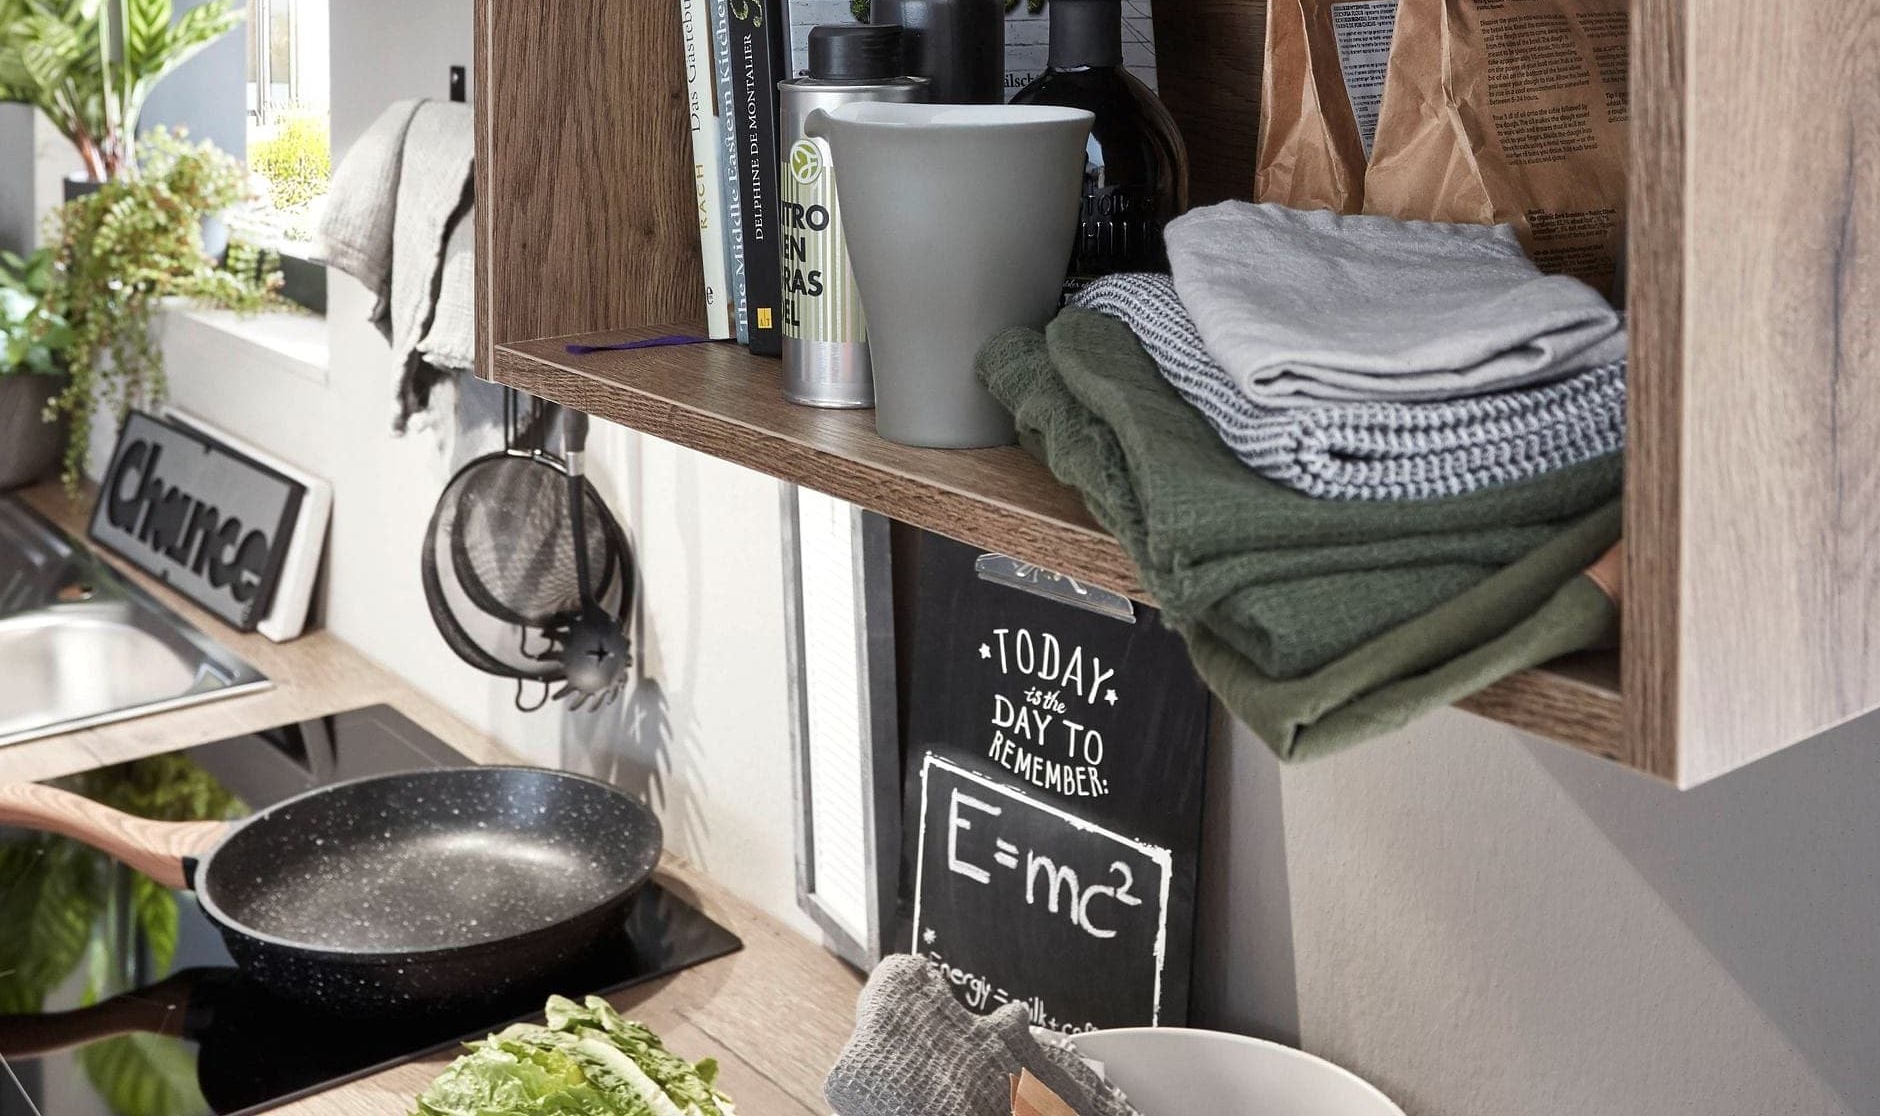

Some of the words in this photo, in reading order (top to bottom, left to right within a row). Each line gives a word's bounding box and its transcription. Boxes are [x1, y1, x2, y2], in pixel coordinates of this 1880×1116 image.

[690, 91, 700, 131] Das
[743, 32, 757, 129] MONTALIER
[723, 92, 738, 181] Eastern
[749, 133, 759, 155] DE
[695, 164, 707, 229] RACH
[751, 159, 763, 241] DELPHINE
[729, 189, 745, 275] Middle
[737, 283, 748, 331] The
[992, 628, 1114, 704] TODAY
[1023, 686, 1043, 705] is
[1043, 690, 1067, 714] the
[988, 730, 1109, 797] REMEMBER:
[991, 694, 1052, 745] DAY
[1062, 719, 1103, 765] TO
